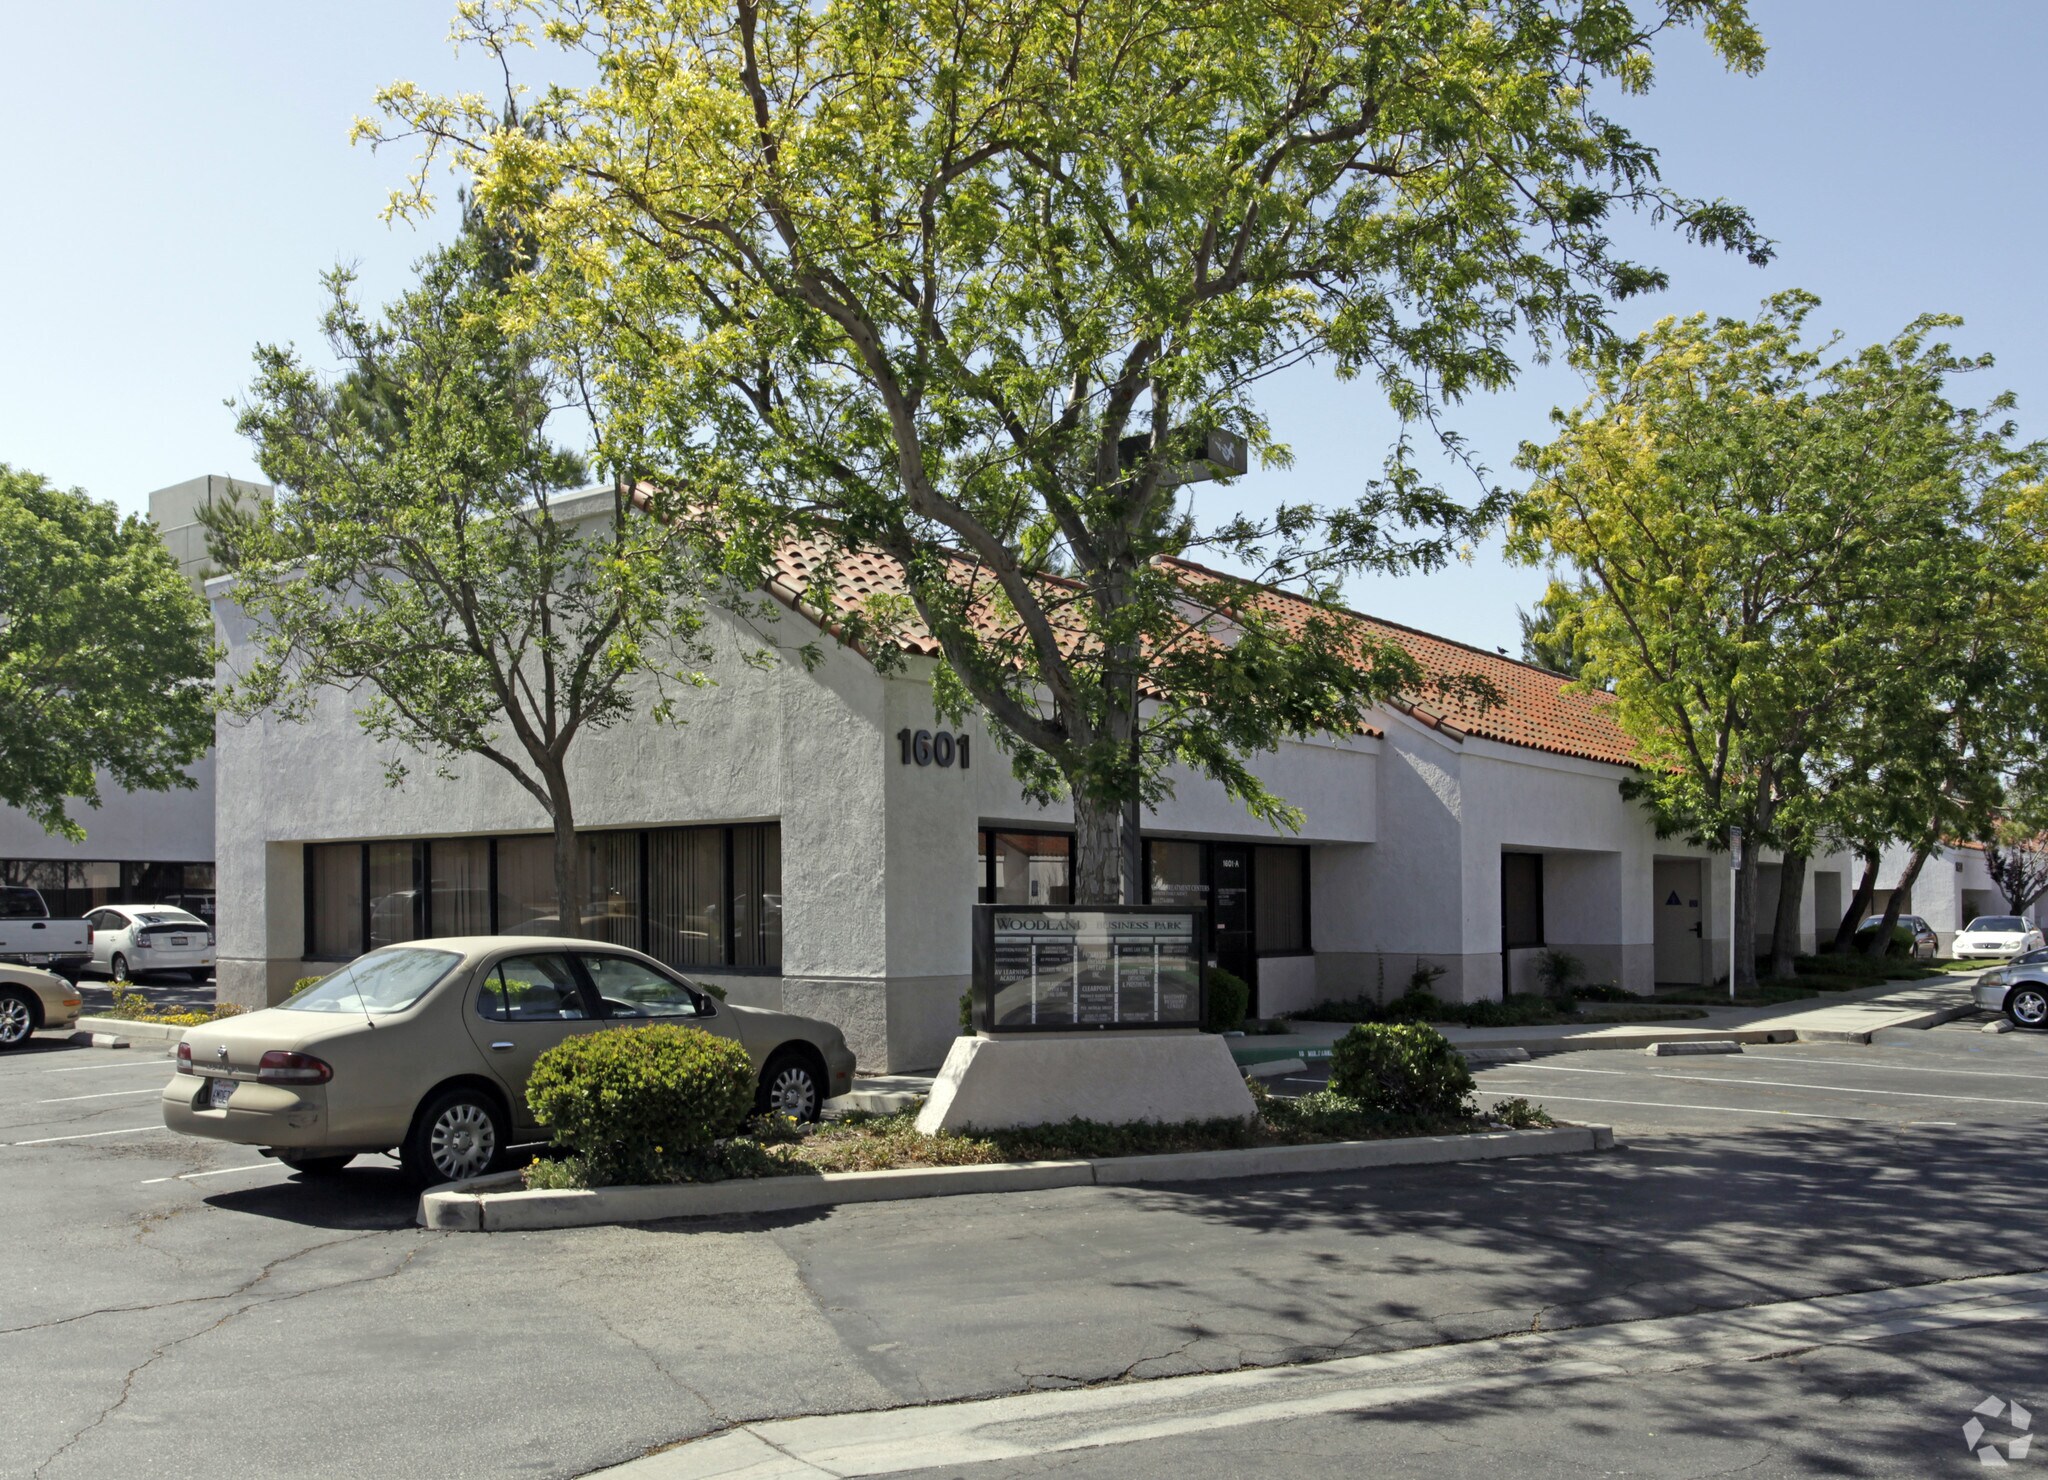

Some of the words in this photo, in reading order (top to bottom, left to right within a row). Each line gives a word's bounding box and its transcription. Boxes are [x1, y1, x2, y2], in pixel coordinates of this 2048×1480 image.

[897, 728, 970, 769] 1601
[997, 917, 1087, 931] WOODLAND
[1154, 920, 1182, 930] PARK
